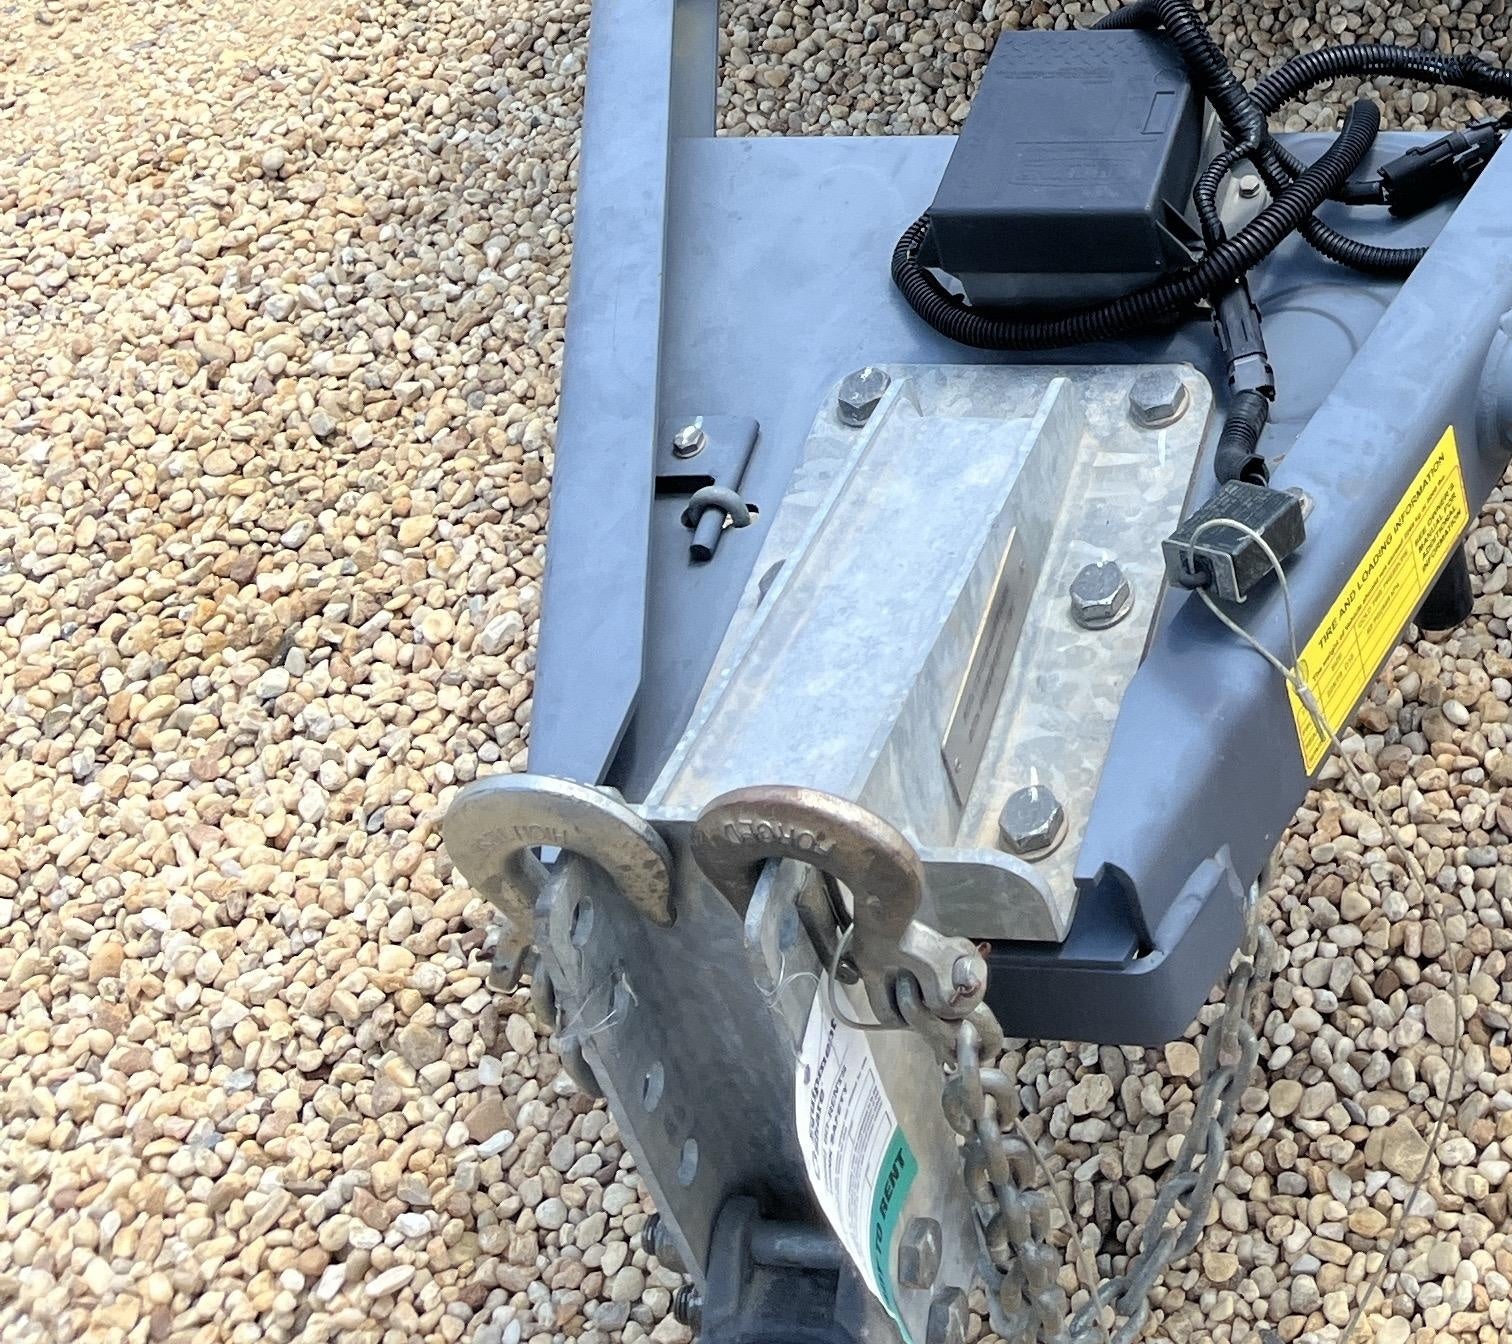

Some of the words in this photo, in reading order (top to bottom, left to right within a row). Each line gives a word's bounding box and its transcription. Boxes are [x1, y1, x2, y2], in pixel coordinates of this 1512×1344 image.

[1318, 618, 1337, 653] TIRE
[1338, 589, 1356, 622] AND
[1356, 533, 1392, 593] LOADING
[1393, 451, 1444, 537] INFORMATION
